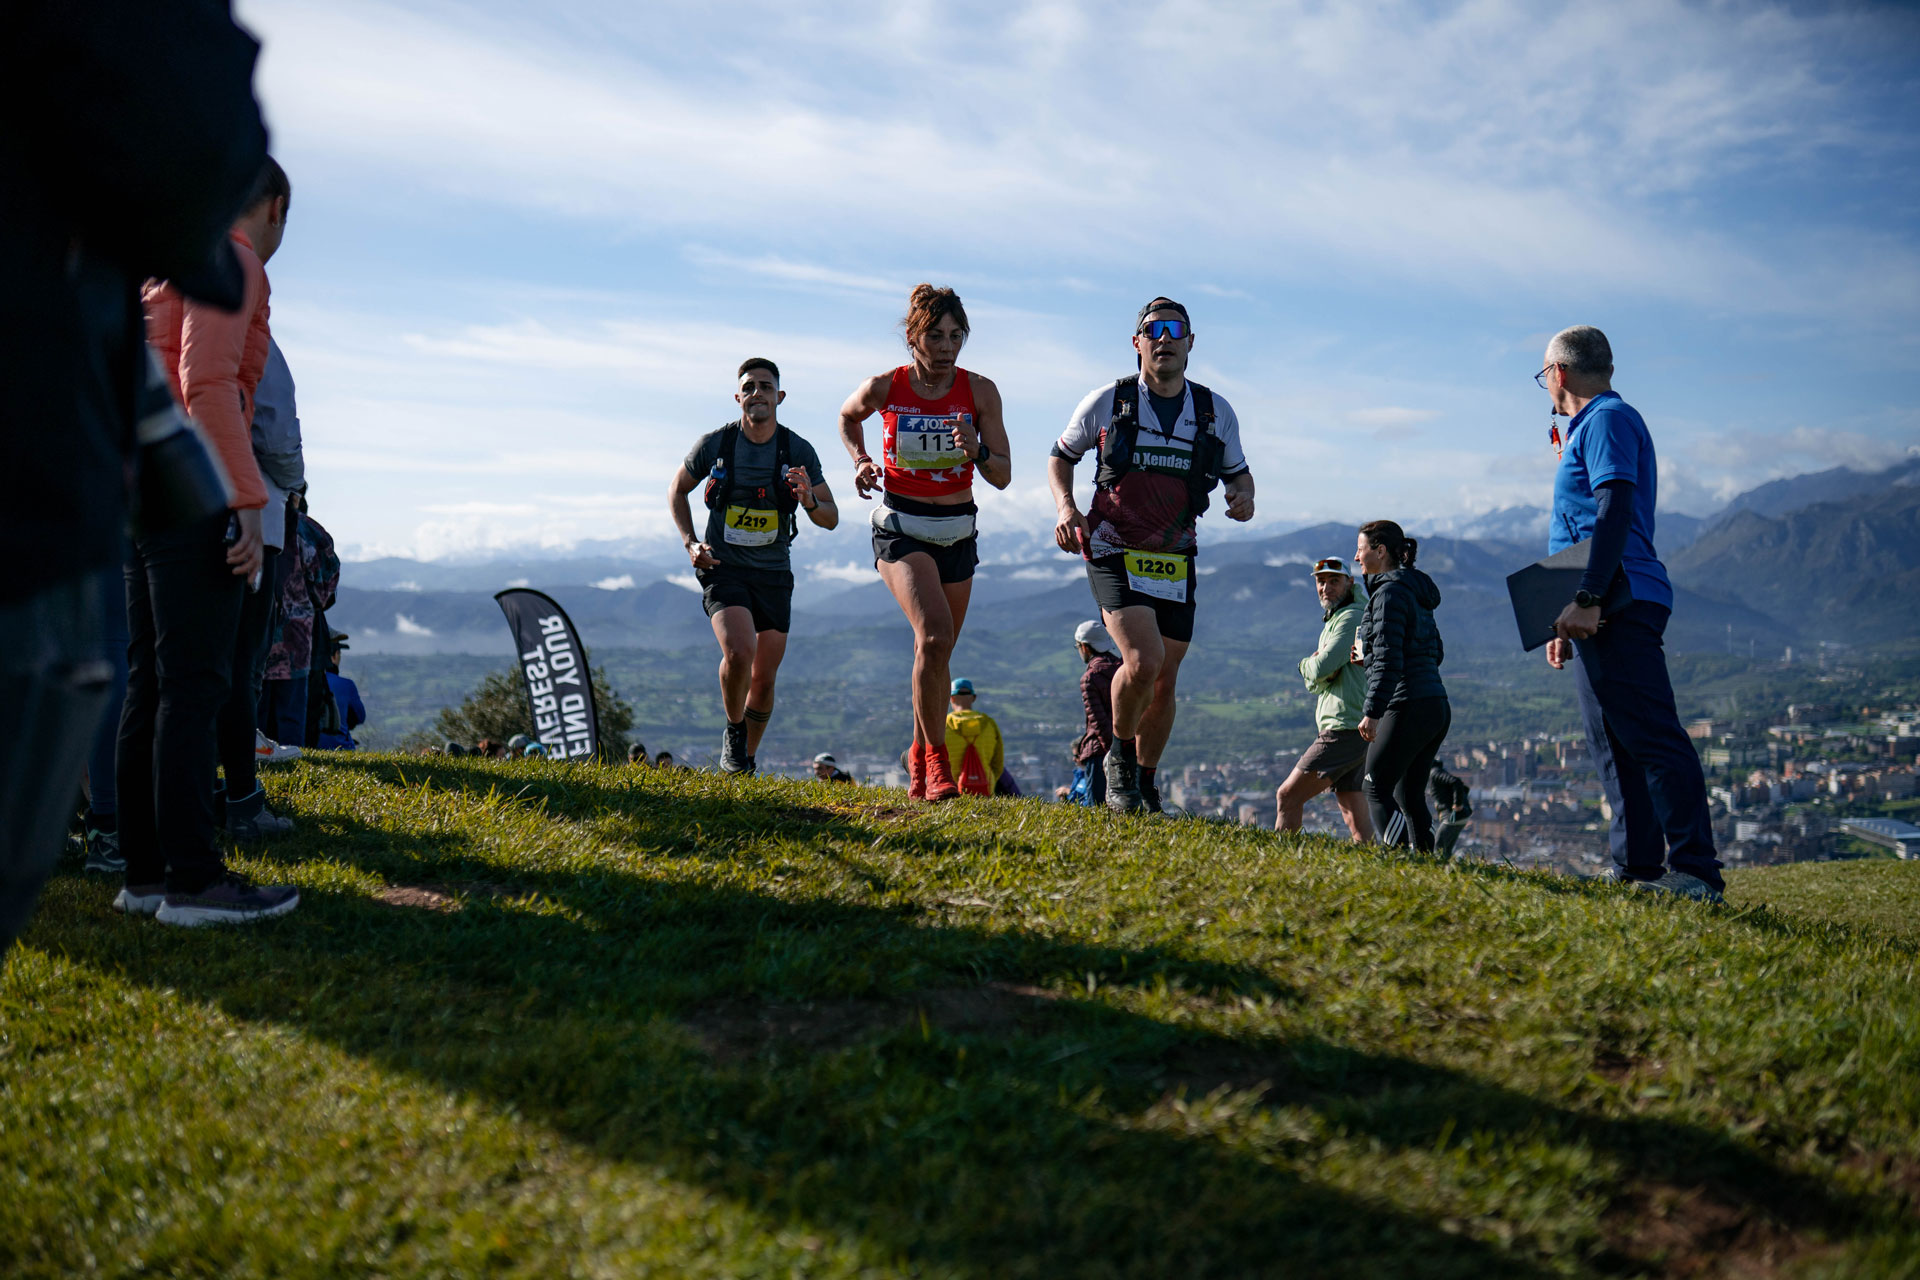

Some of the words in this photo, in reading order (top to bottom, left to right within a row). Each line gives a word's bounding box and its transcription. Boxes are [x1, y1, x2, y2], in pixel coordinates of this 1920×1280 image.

[918, 433, 956, 451] 113
[1142, 451, 1192, 471] Xendas
[738, 515, 768, 528] 1219
[1135, 559, 1176, 575] 1220
